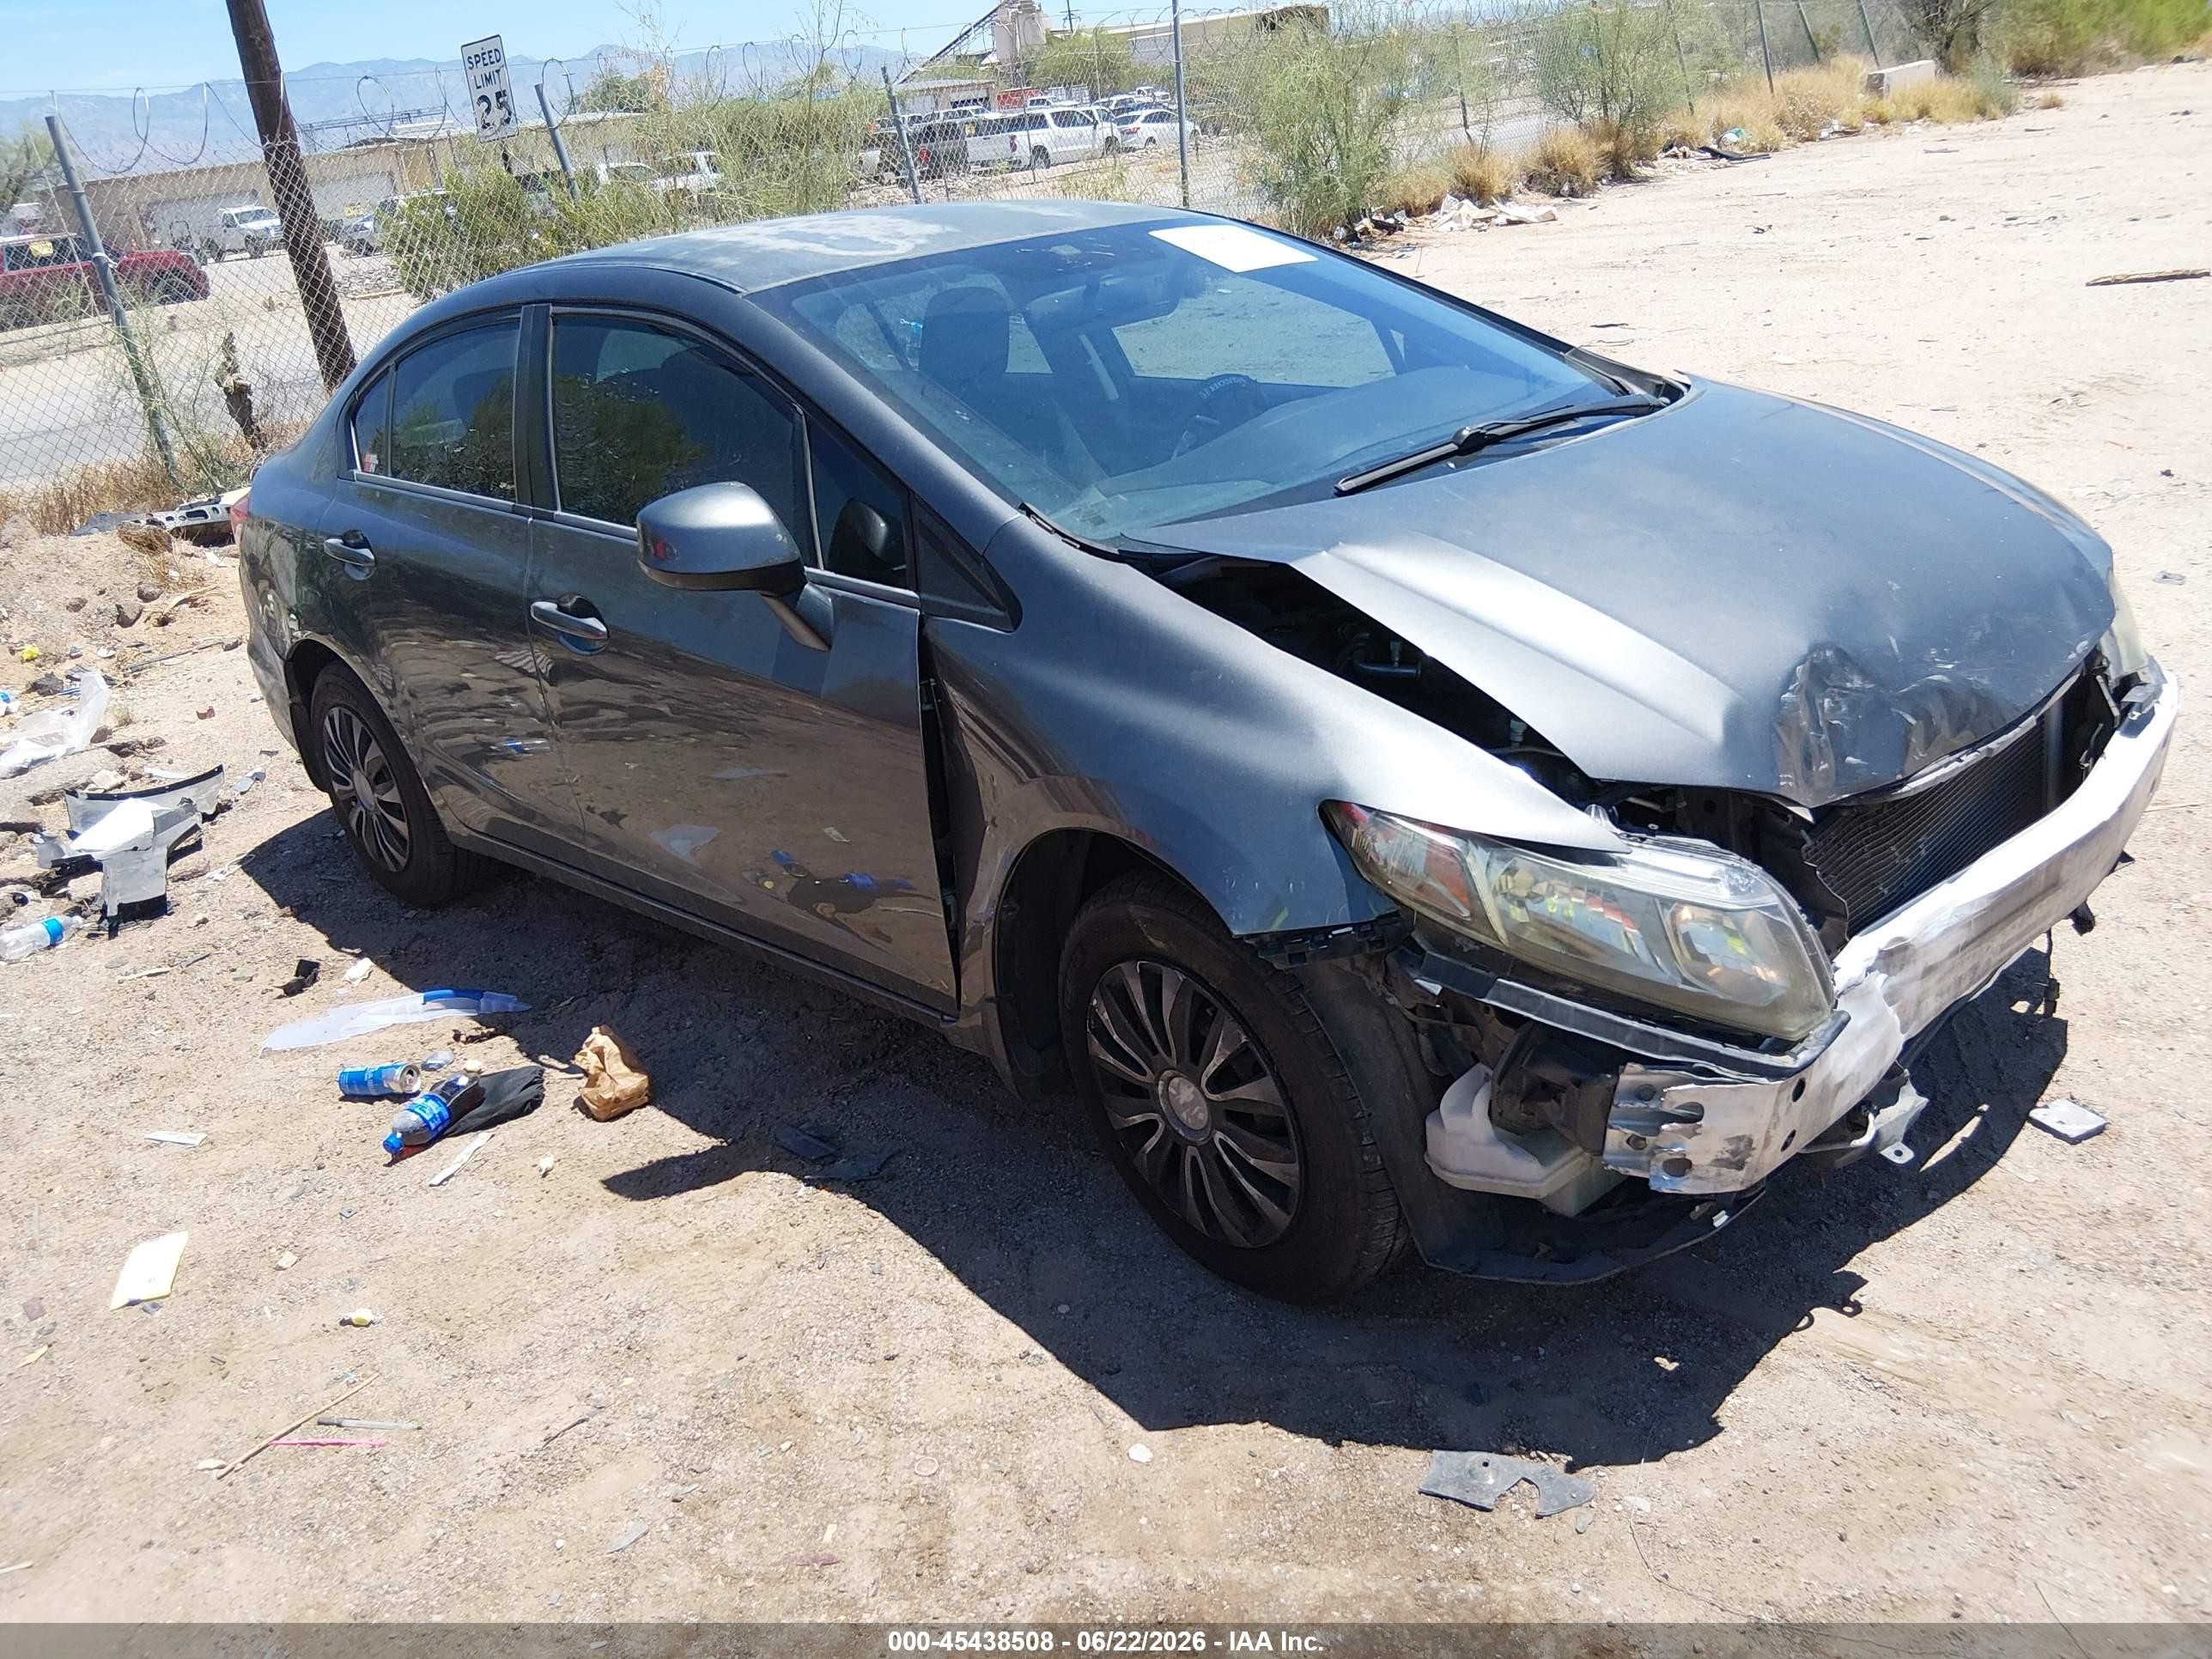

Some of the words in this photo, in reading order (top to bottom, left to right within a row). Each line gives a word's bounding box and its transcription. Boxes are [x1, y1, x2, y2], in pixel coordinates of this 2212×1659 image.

[467, 48, 501, 70] SPEED
[473, 65, 504, 89] LIMIT
[477, 89, 512, 130] 25
